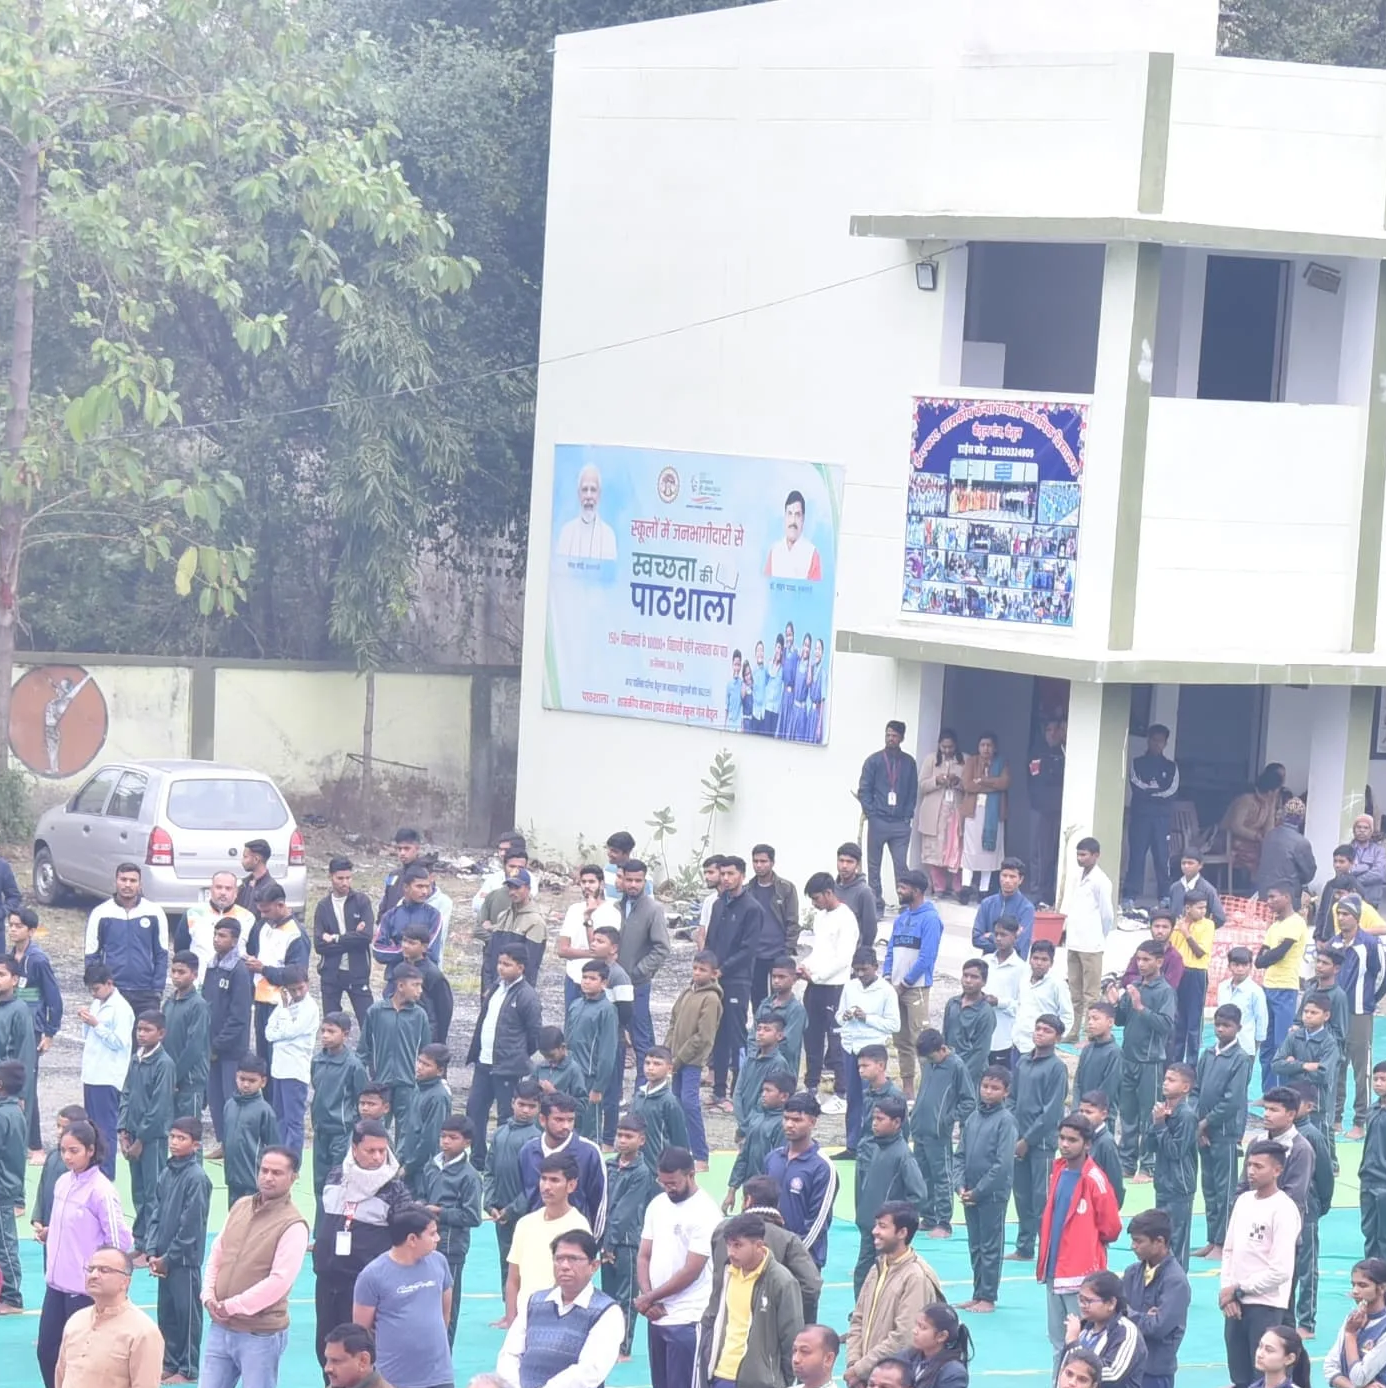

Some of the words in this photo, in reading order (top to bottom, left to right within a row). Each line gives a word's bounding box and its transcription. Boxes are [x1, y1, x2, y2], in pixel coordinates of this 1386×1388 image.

[631, 516, 660, 543] स्कूलों
[661, 517, 671, 540] में
[672, 521, 732, 546] जनभागीदारी
[734, 523, 744, 546] से
[632, 552, 697, 582] स्वच्छता
[699, 565, 713, 584] की
[630, 582, 736, 625] पाठशाला
